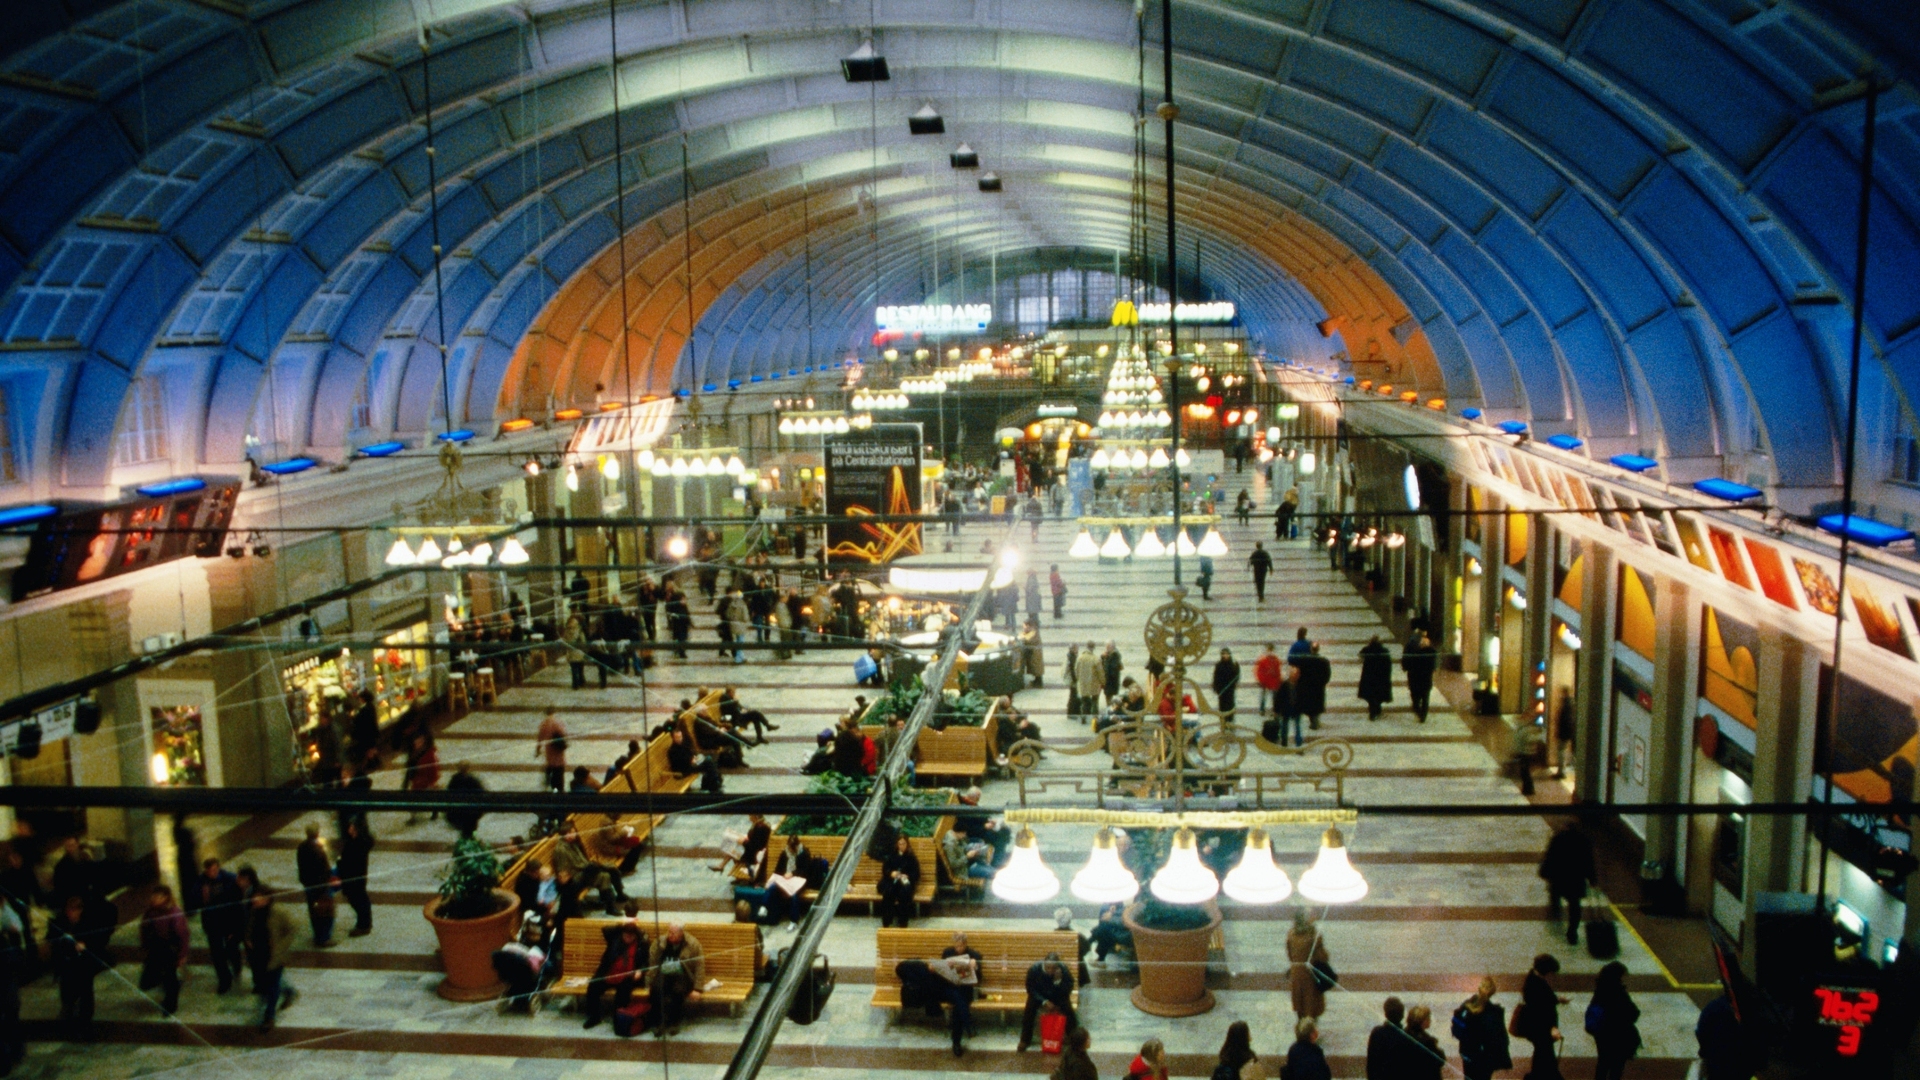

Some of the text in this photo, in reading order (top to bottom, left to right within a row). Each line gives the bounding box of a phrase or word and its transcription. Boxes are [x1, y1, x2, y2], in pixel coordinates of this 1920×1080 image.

[832, 454, 916, 467] på Centralstationen
[1814, 988, 1879, 1023] 762
[1837, 1025, 1861, 1056] 3
